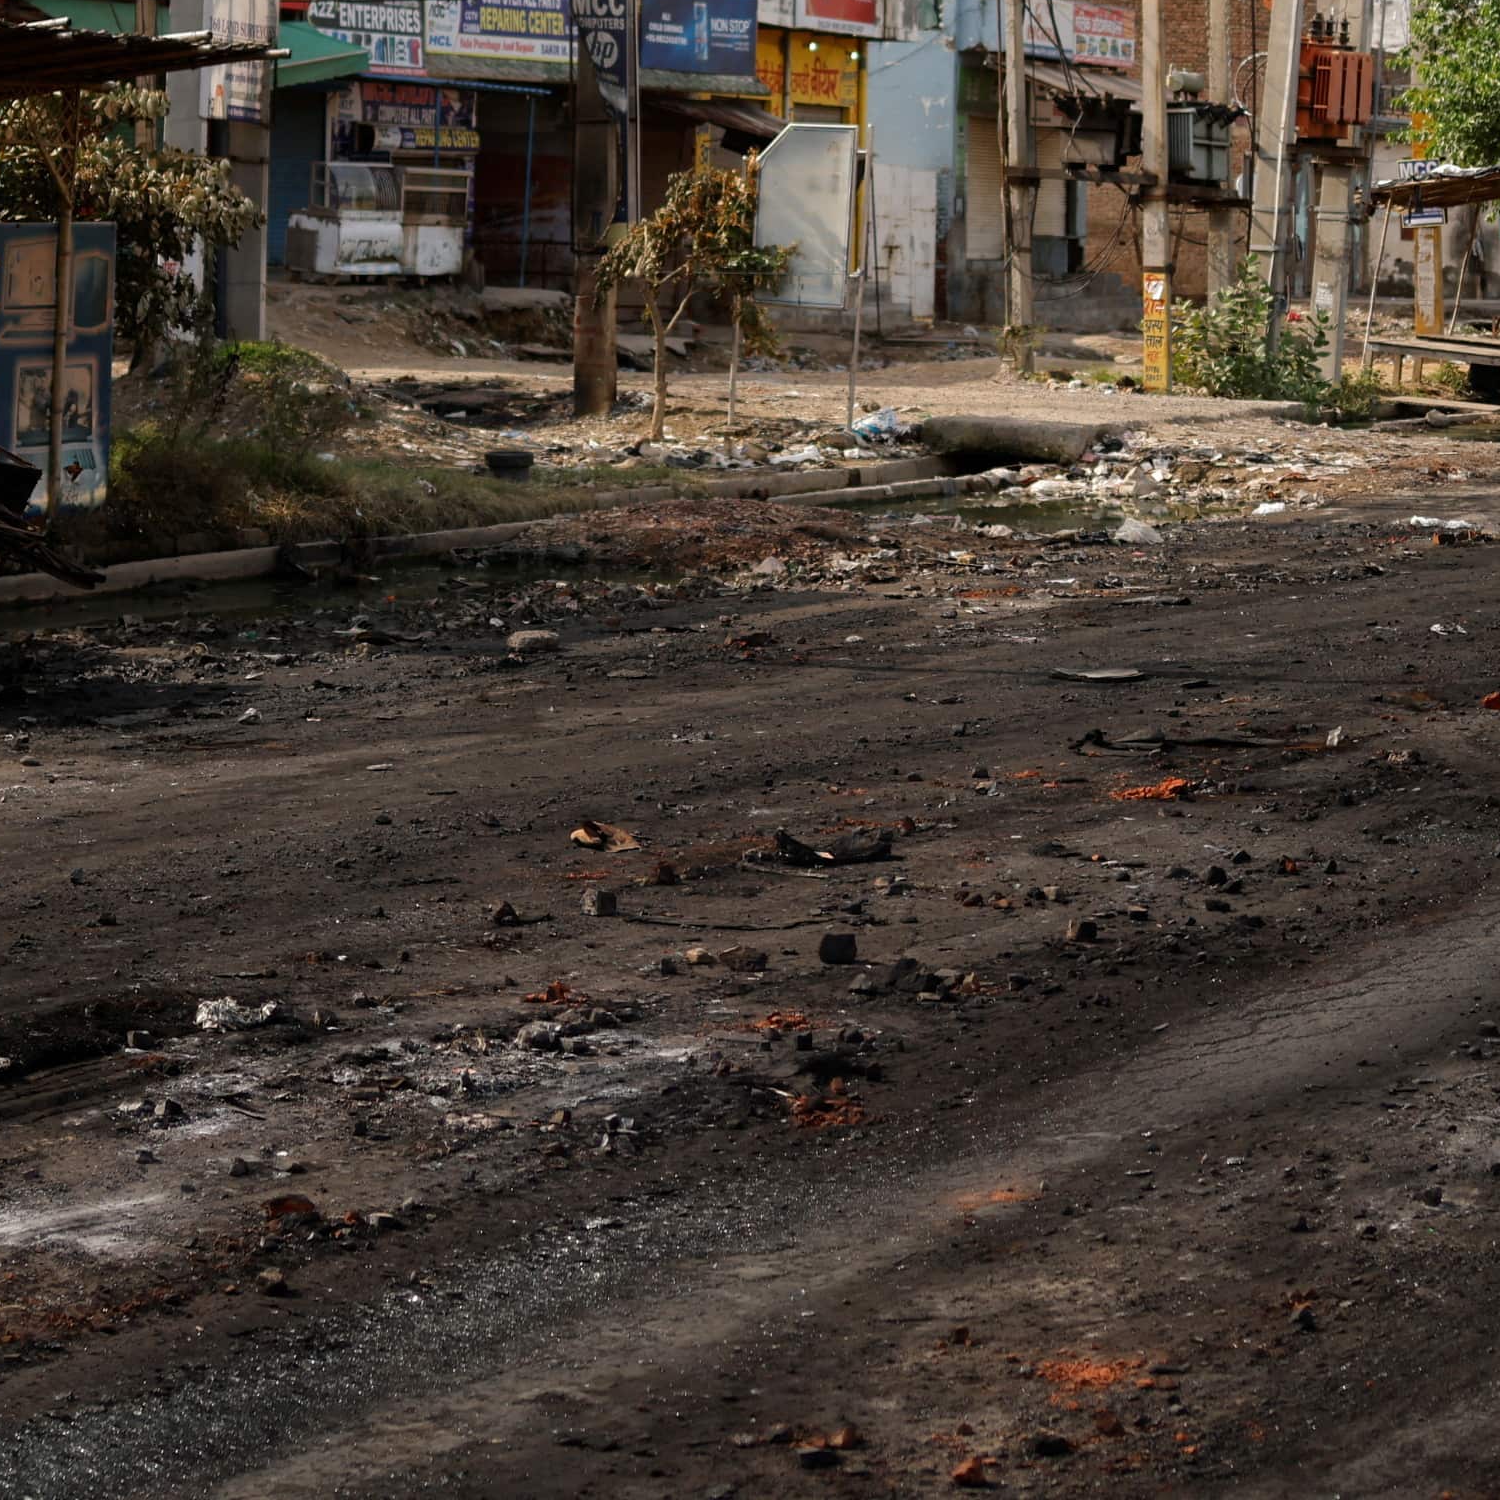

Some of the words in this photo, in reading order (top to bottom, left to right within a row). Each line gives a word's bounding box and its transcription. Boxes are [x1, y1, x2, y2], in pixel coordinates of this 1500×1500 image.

[309, 1, 335, 19] A2Z
[339, 2, 421, 33] ENTERPRISES
[479, 6, 527, 34] REPARING
[528, 11, 565, 36] CENTER
[428, 35, 453, 48] HCL
